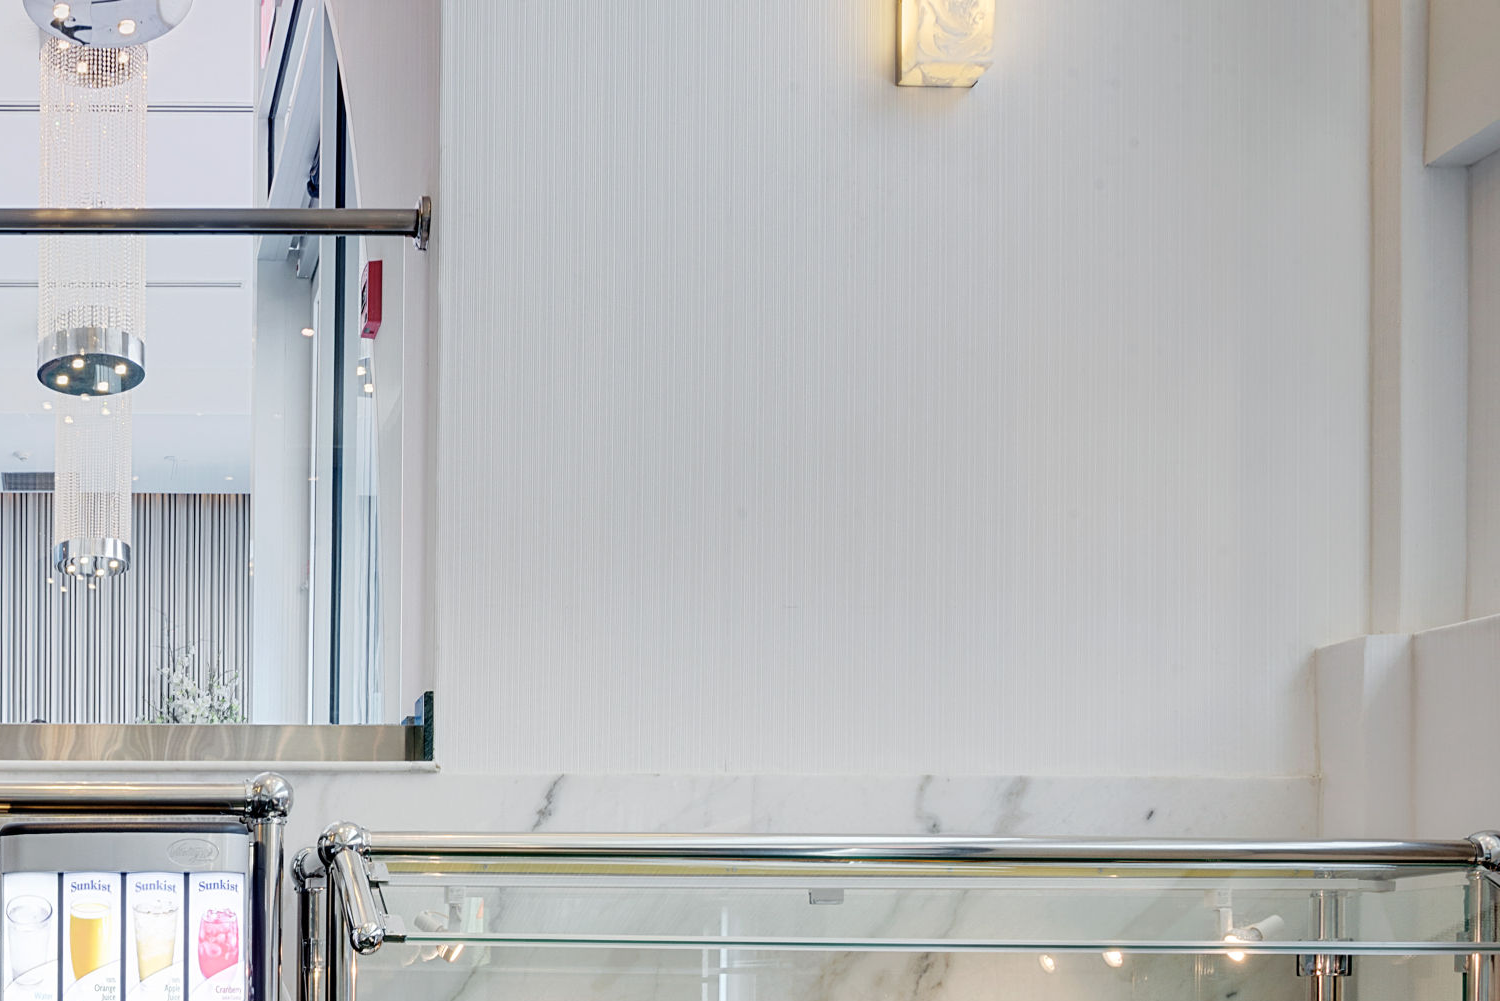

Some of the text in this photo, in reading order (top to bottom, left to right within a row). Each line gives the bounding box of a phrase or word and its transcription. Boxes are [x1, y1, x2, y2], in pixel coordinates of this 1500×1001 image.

[70, 879, 112, 893] Sunkist
[135, 879, 177, 893] Sunkist
[198, 879, 239, 893] Sunkist
[94, 984, 116, 993] Orange
[101, 994, 116, 1001] Juice
